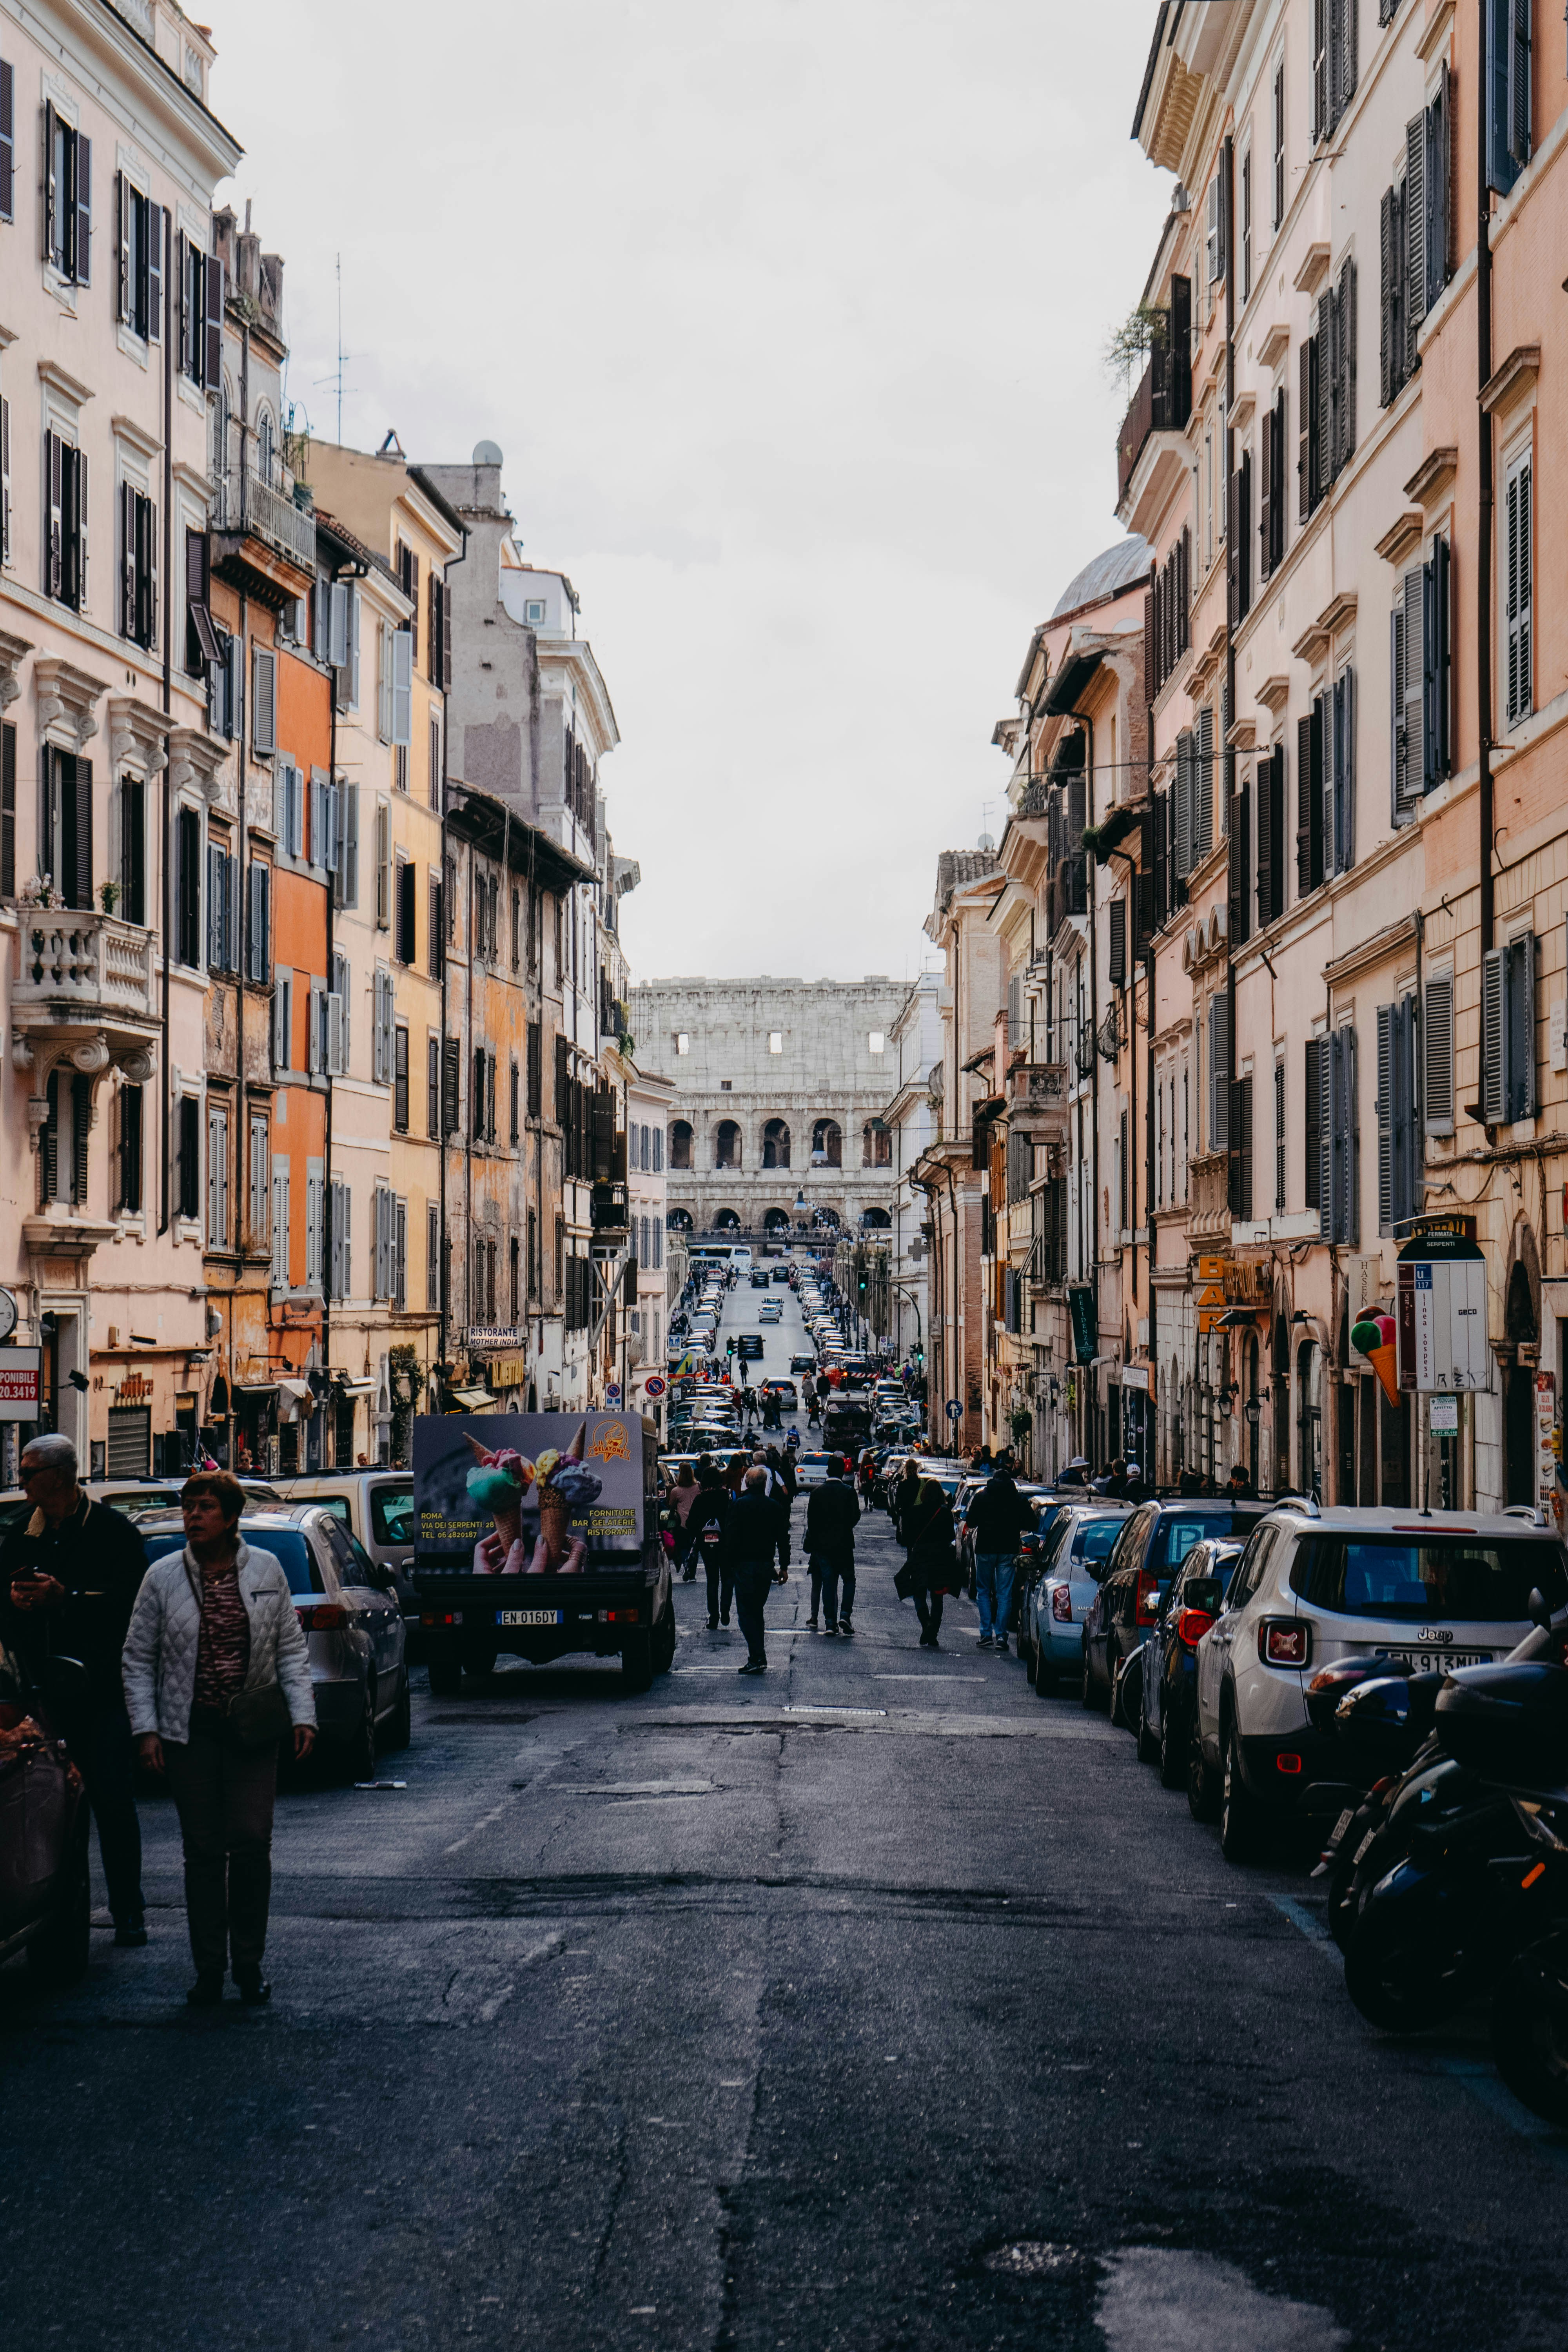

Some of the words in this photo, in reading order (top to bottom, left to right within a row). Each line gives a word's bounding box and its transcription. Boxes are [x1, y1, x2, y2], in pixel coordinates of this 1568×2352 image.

[1198, 1257, 1230, 1333] BAR
[471, 1328, 517, 1336] RISTORANTE
[1079, 1294, 1089, 1346] RESIDENZA
[0, 1385, 35, 1398] 20.3419
[1176, 1528, 1201, 1561] P
[1418, 1628, 1453, 1643] Jeep
